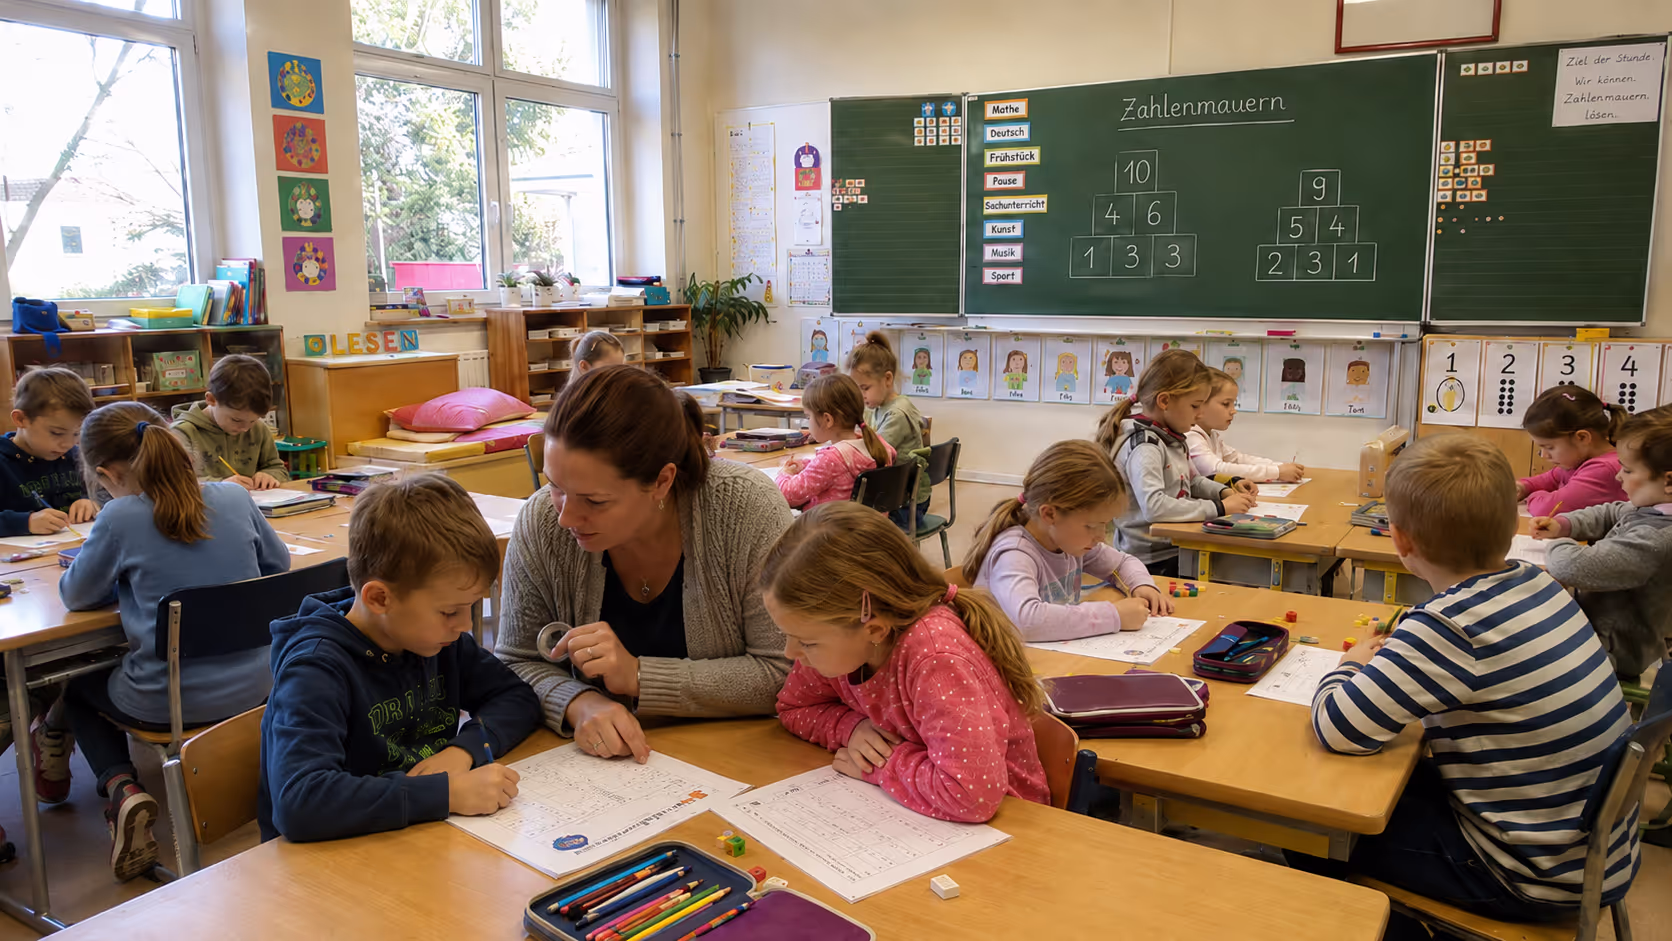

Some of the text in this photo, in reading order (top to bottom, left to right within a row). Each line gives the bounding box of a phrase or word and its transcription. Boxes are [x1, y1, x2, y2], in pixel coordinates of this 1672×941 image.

[1566, 55, 1588, 67] Ziel
[1593, 54, 1612, 65] der
[1575, 76, 1592, 86] Wir
[992, 103, 1020, 115] Mathe
[1120, 94, 1287, 121] Zahlenmauern
[1563, 92, 1650, 104] Zahlenmauern.
[990, 127, 1025, 138] Deutsch
[989, 150, 1036, 163] Frühstück
[992, 176, 1018, 186] Pause
[1124, 159, 1152, 185] 10
[1312, 176, 1327, 200] 9
[985, 199, 1046, 210] Sachunterricht
[1105, 203, 1121, 226] 4
[1147, 201, 1162, 226] 6
[991, 224, 1016, 234] Kunst
[1289, 216, 1304, 239] 5
[1329, 214, 1346, 237] 4
[991, 247, 1016, 258] Musik
[1083, 247, 1095, 269] 1
[1124, 245, 1141, 269] 3
[1165, 244, 1182, 268] 3
[1268, 252, 1284, 275] 2
[1307, 251, 1323, 274] 3
[1347, 251, 1359, 273] 1
[991, 270, 1016, 282] Sport
[1446, 352, 1458, 373] 1
[1500, 353, 1516, 375] 2
[1560, 354, 1576, 376] 3
[1620, 355, 1638, 377] 4
